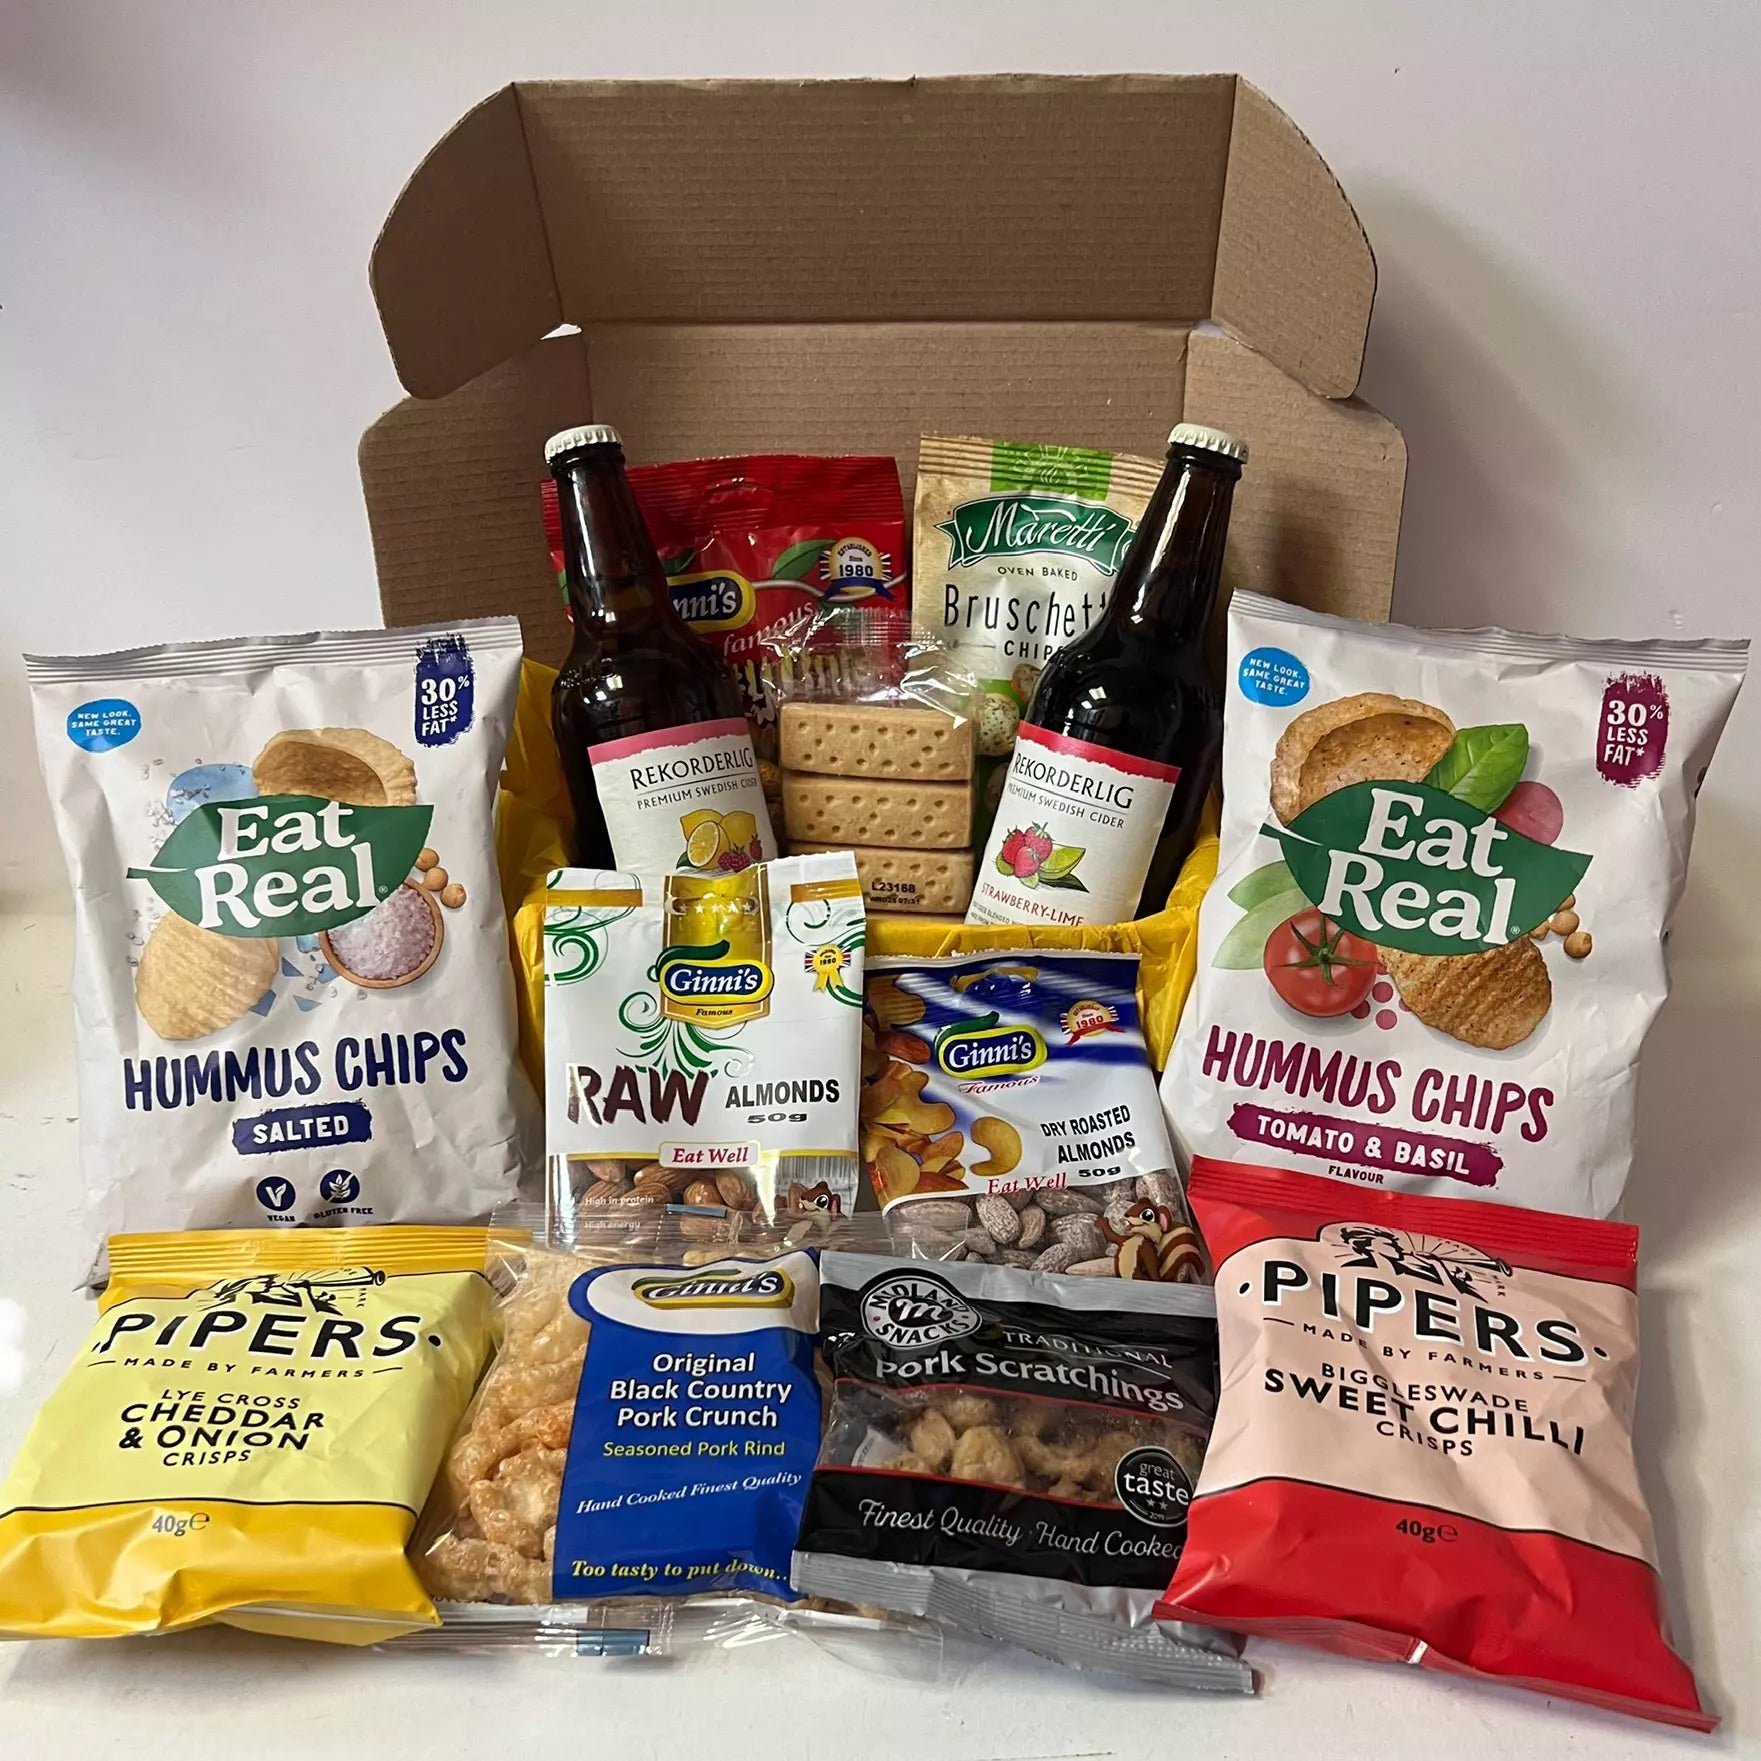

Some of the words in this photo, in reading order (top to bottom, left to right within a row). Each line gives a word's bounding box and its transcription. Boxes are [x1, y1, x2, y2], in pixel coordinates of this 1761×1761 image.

[966, 501, 1110, 552] Maretti
[839, 564, 873, 577] 1980
[997, 566, 1034, 577] OVEN
[1042, 567, 1079, 581] BAKED
[1004, 640, 1064, 660] CHIP
[1249, 658, 1271, 669] NEW
[421, 674, 471, 705] 30%
[1243, 668, 1271, 680] SAME
[1273, 675, 1306, 689] GREAT
[422, 700, 459, 721] LESS
[1606, 699, 1664, 728] 30%
[71, 720, 100, 729] SAME
[103, 719, 137, 727] GREAT
[1607, 727, 1648, 746] LESS
[630, 747, 754, 789] REKORDERLIG
[1012, 752, 1134, 809] REKORDERLIG
[637, 790, 693, 810] PREMIUM
[696, 780, 738, 798] SWEDISH
[1038, 795, 1085, 818] SWEDISH
[1089, 811, 1125, 829] CIDER
[217, 801, 356, 860] Eat
[1359, 788, 1509, 877] Eat
[195, 842, 379, 928] Real
[1317, 849, 1516, 945] Real
[669, 968, 759, 994] Ginni's
[695, 1007, 733, 1016] Famous
[1076, 1015, 1104, 1029] 1980
[949, 1035, 1032, 1070] Ginni's
[123, 1040, 322, 1111] HUMMUS
[335, 1028, 469, 1091] CHIPS
[566, 1062, 709, 1127] RAW
[725, 1079, 840, 1109] ALMONDS
[959, 1075, 1040, 1095] Famous
[1201, 1025, 1401, 1114] HUMMUS
[1411, 1068, 1554, 1143] CHIPS
[252, 1115, 349, 1144] SALTED
[747, 1111, 807, 1124] 50g
[1040, 1121, 1067, 1137] DRY
[1069, 1104, 1131, 1136] ROASTED
[672, 1147, 705, 1164] Eat
[709, 1146, 749, 1164] Well
[1058, 1131, 1136, 1164] ALMONDS
[1256, 1114, 1354, 1154] TOMATO
[1364, 1136, 1382, 1159] &
[1394, 1139, 1470, 1176] BASIL
[987, 1176, 1020, 1196] Eat
[1025, 1172, 1068, 1192] Well
[1078, 1166, 1122, 1178] 50g
[1328, 1165, 1385, 1185] FLAVOUR
[267, 1214, 296, 1222] VEGAN
[313, 1207, 348, 1219] GLUTEN
[351, 1207, 373, 1215] FREE
[1262, 1260, 1588, 1364] PIPERS
[876, 1320, 970, 1344] SNACKS
[1002, 1331, 1173, 1368] TRADITIONAL
[1303, 1323, 1367, 1350] MADE
[1383, 1346, 1411, 1360] BY
[1428, 1351, 1545, 1380] FARMERS
[123, 1357, 193, 1370] MADE
[207, 1362, 238, 1374] BY
[251, 1365, 365, 1379] FARMERS
[653, 1352, 755, 1377] Original
[610, 1379, 679, 1400] Black
[687, 1380, 792, 1403] Country
[876, 1350, 966, 1378] Pork
[975, 1352, 1185, 1413] Scratchings
[1321, 1362, 1528, 1413] BIGGLESWADE
[161, 1389, 205, 1402] LYE
[217, 1393, 301, 1409] CROSS
[1264, 1368, 1415, 1423] SWEET
[1429, 1406, 1584, 1456] CHILLI
[121, 1403, 324, 1430] CHEDDAR
[617, 1406, 678, 1427] Pork
[685, 1406, 778, 1428] Crunch
[118, 1427, 143, 1449] &
[157, 1425, 309, 1450] ONION
[603, 1442, 691, 1456] Seasoned
[698, 1441, 738, 1456] Pork
[744, 1441, 785, 1456] Rind
[1376, 1420, 1474, 1457] CRISPS
[162, 1450, 251, 1467] CRISPS
[1139, 1463, 1175, 1480] great
[576, 1495, 624, 1514] Hand
[627, 1486, 686, 1506] Cooked
[690, 1480, 738, 1497] Finest
[743, 1472, 802, 1491] Quality
[1123, 1473, 1190, 1505] taste
[858, 1499, 936, 1530] Finest
[940, 1506, 1023, 1547] Quality
[1035, 1521, 1100, 1554] Hand
[571, 1560, 605, 1577] Too
[611, 1561, 658, 1581] tasty
[664, 1562, 683, 1577] to
[687, 1562, 720, 1580] put
